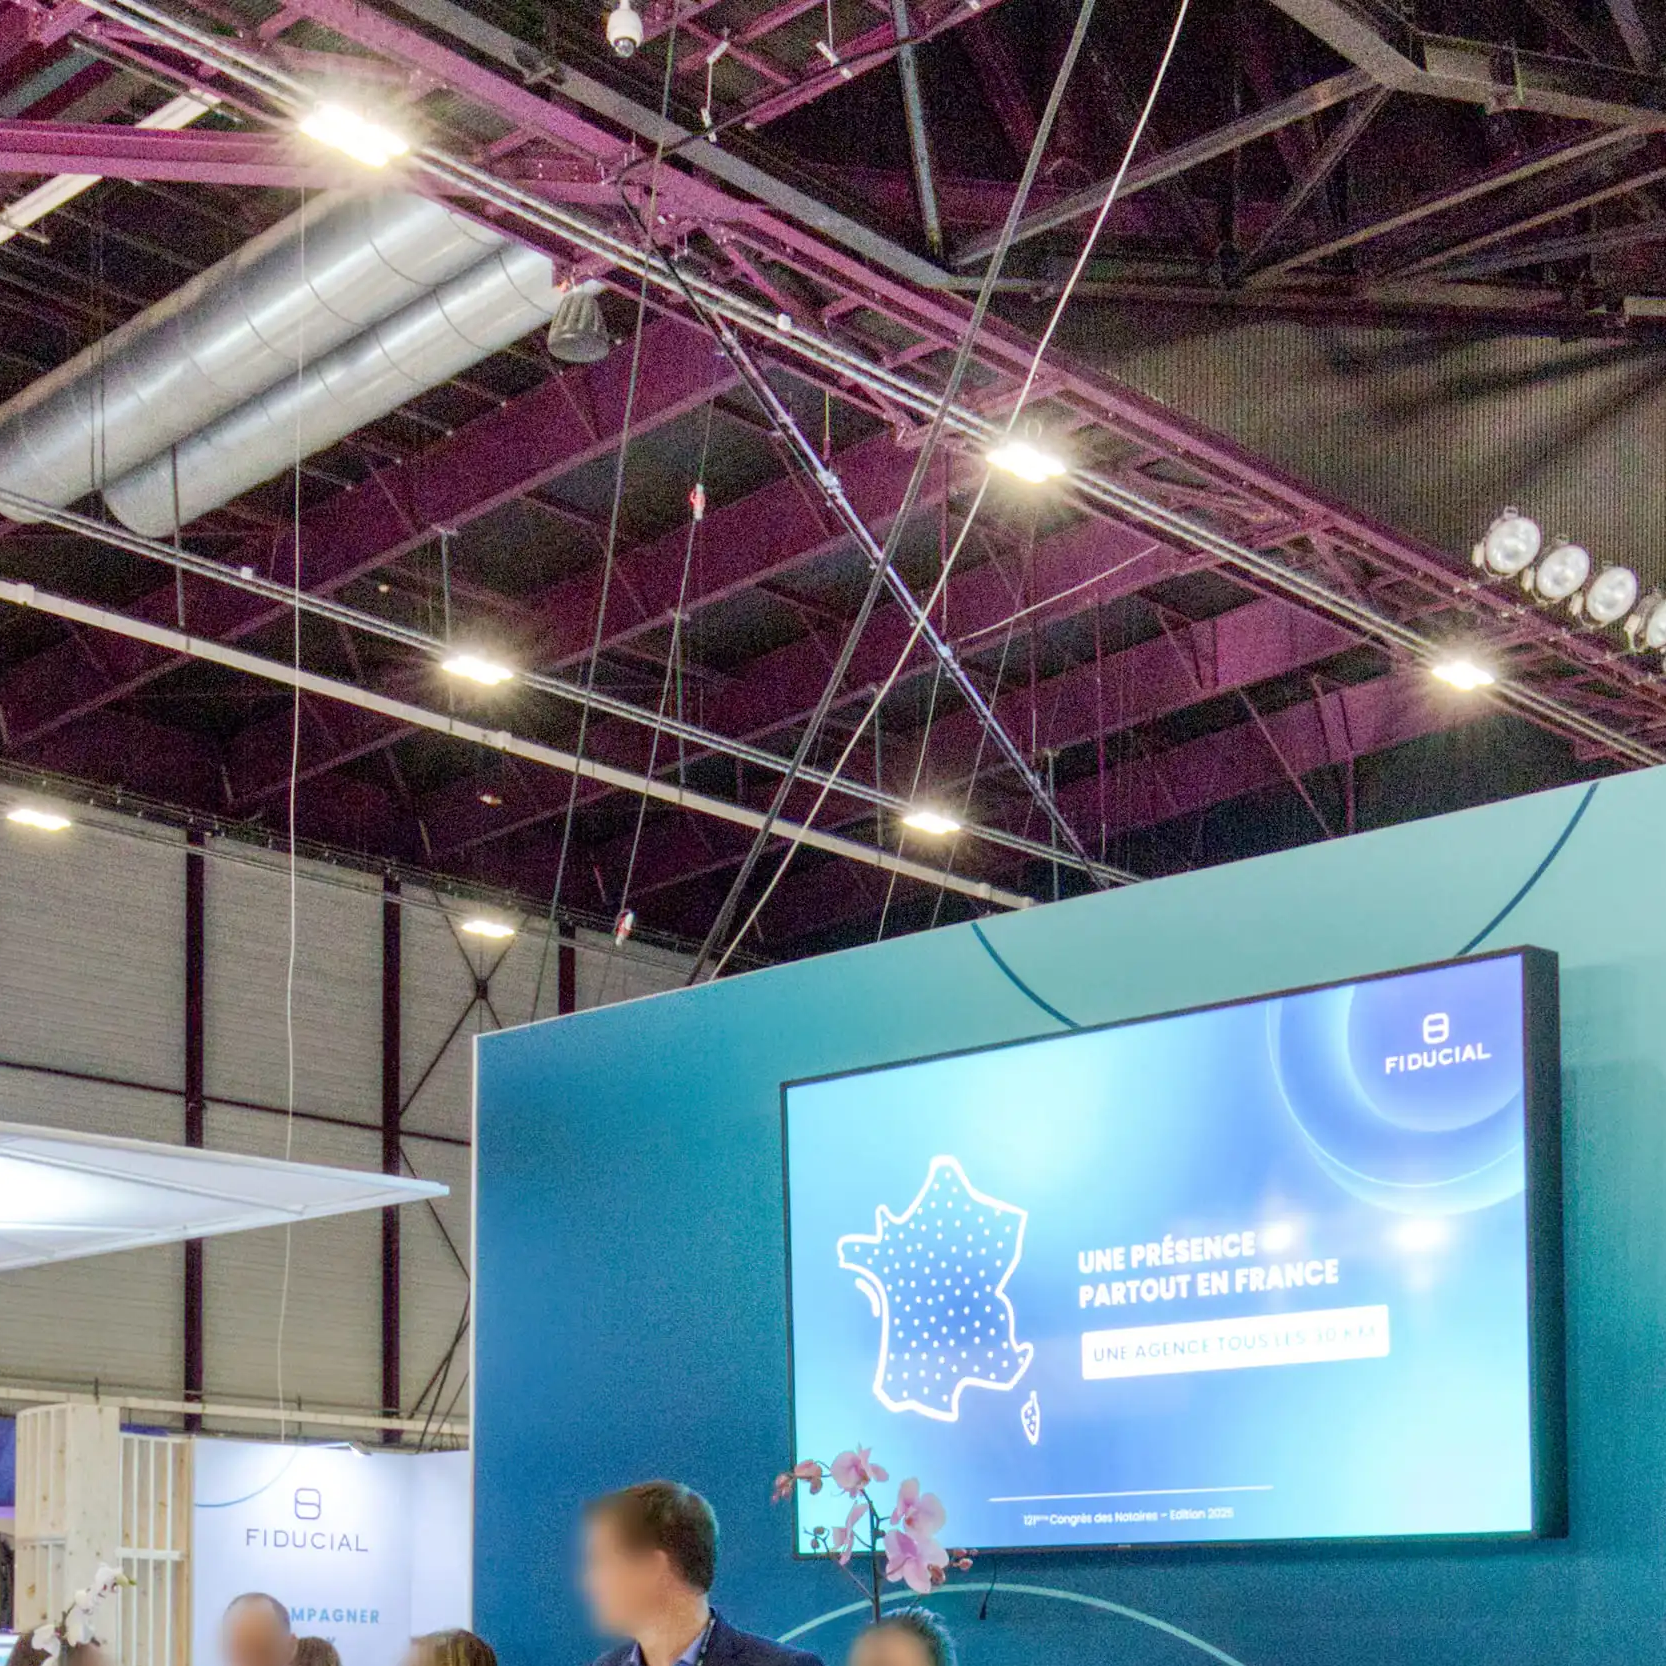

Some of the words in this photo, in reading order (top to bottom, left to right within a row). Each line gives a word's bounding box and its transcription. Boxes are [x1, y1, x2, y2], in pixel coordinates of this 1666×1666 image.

[1385, 1042, 1492, 1076] FIDUCIAL
[1078, 1247, 1126, 1274] UNE
[1130, 1231, 1256, 1270] PRÉSENCE
[1078, 1275, 1191, 1309] PARTOUT
[1197, 1271, 1229, 1297] EN
[1234, 1258, 1339, 1294] FRANCE
[1094, 1345, 1128, 1362] UNE
[1135, 1339, 1209, 1359] AGENCE
[1218, 1329, 1268, 1351] TOUS
[1049, 1512, 1093, 1528] Congrès
[1093, 1512, 1114, 1525] des
[1115, 1510, 1159, 1524] Notaires
[245, 1528, 369, 1553] FIDUCIAL
[290, 1606, 380, 1625] MPAGNER
